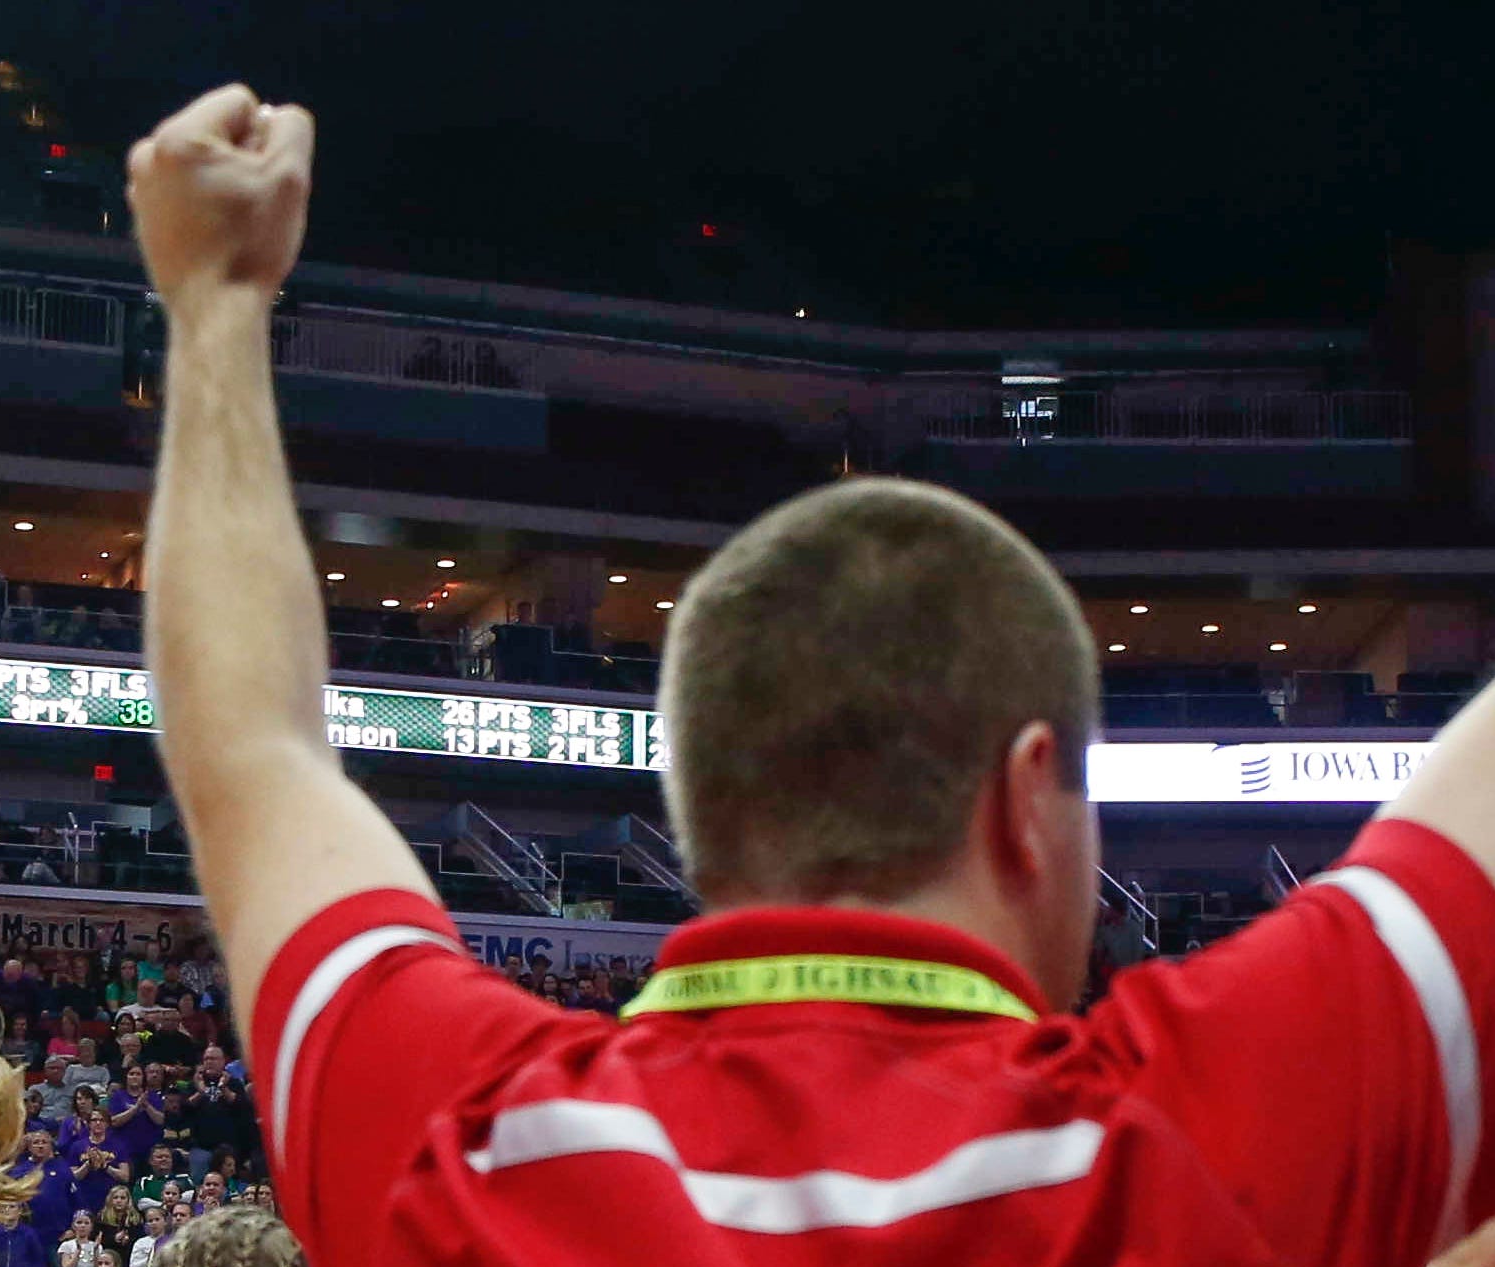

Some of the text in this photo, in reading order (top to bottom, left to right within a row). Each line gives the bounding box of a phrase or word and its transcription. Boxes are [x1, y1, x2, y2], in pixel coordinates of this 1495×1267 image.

[119, 700, 154, 726] 38
[1289, 751, 1380, 781] IOWA
[1, 912, 95, 950] March
[461, 933, 553, 969] EMC
